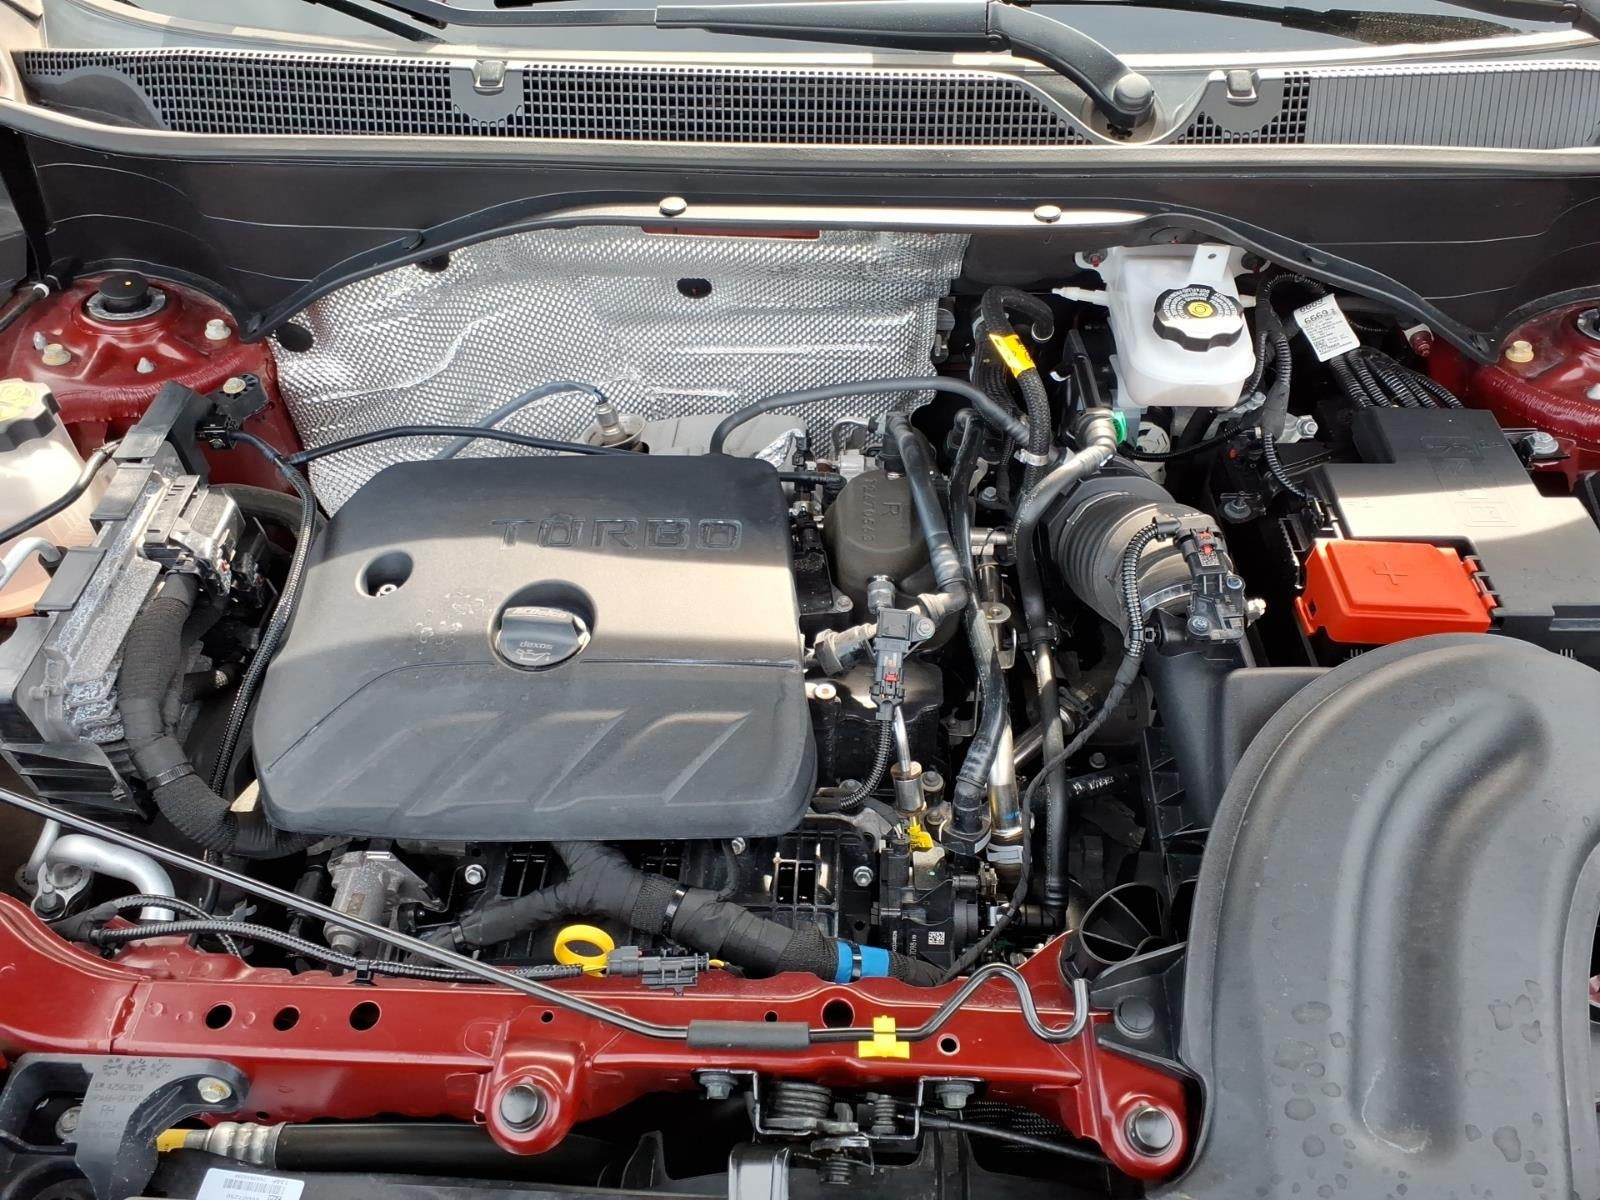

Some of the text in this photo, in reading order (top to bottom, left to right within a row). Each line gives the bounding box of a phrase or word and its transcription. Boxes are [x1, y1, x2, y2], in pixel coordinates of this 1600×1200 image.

[1304, 309, 1329, 325] 6669
[881, 501, 904, 517] R
[489, 515, 744, 551] TURBO
[519, 640, 554, 650] dexos
